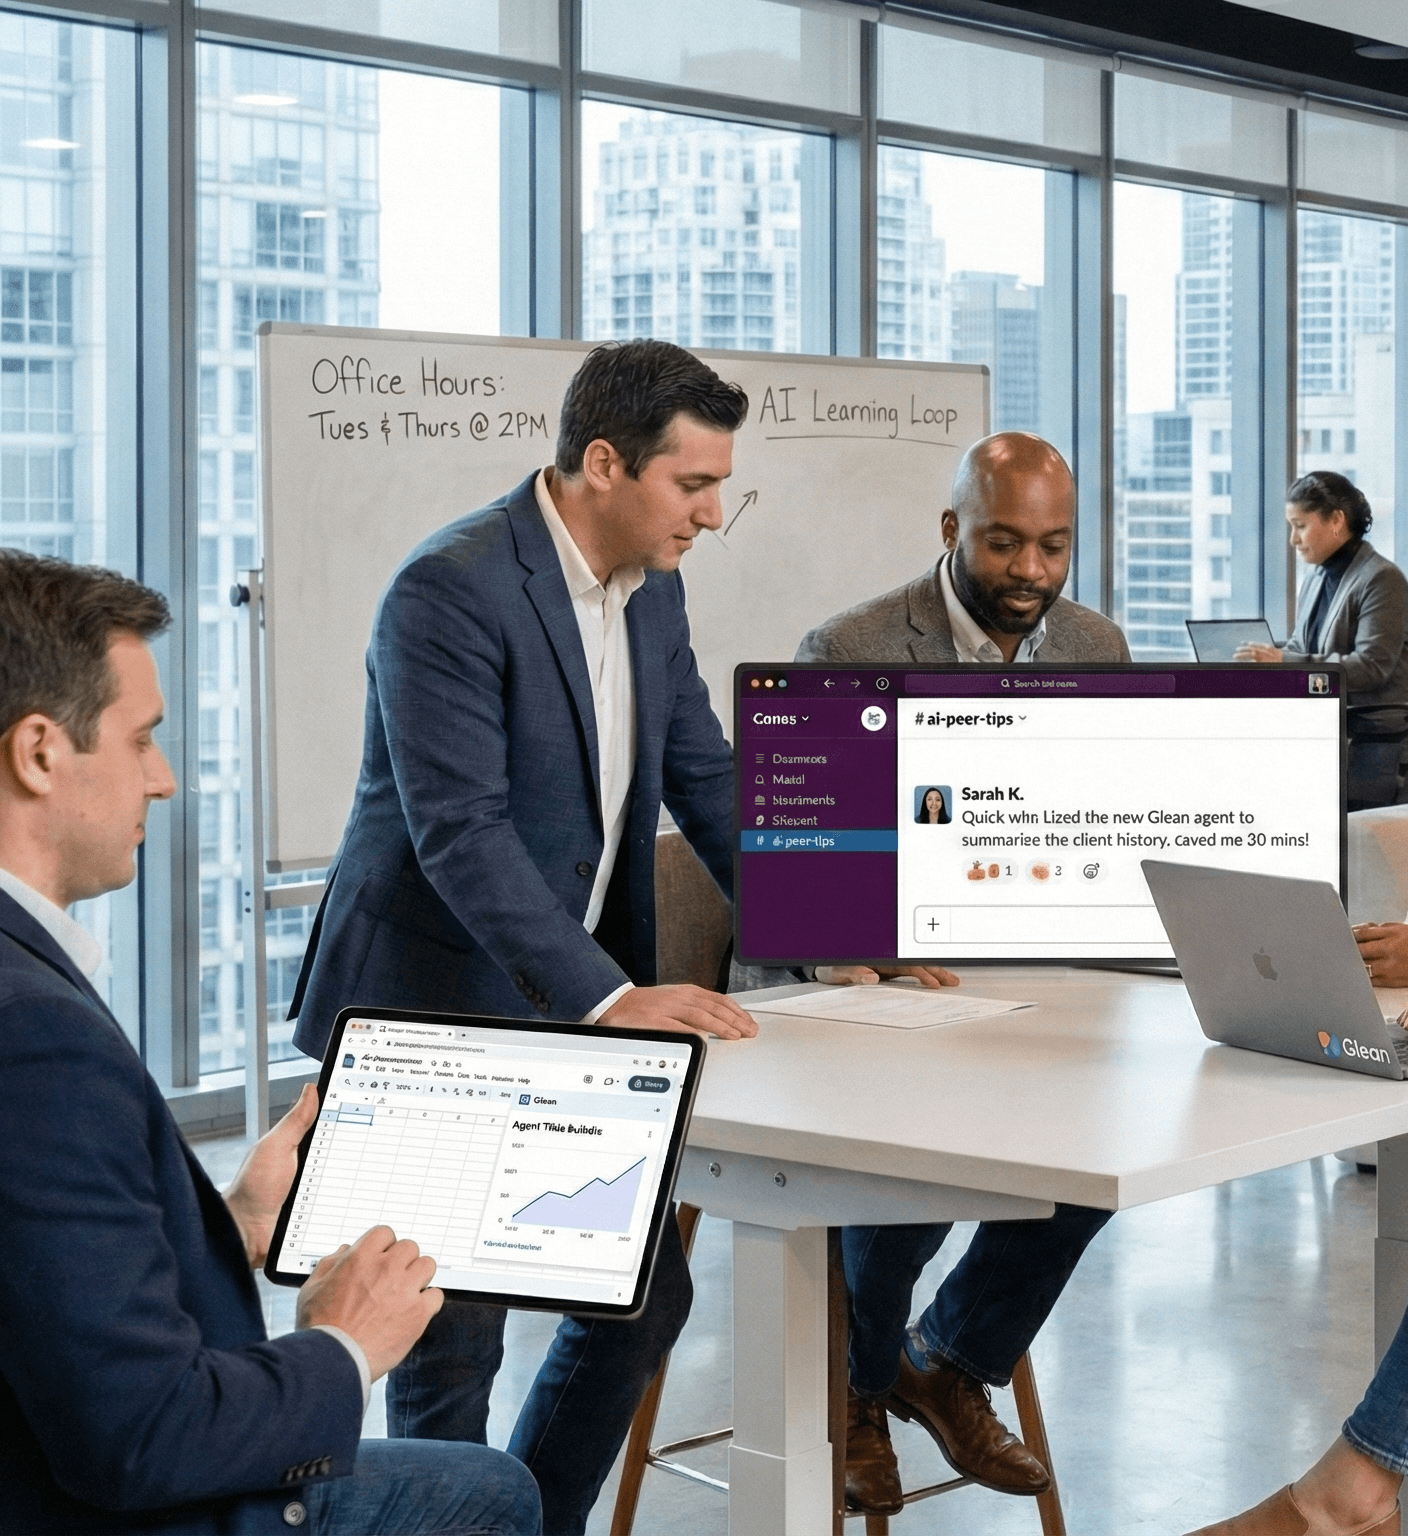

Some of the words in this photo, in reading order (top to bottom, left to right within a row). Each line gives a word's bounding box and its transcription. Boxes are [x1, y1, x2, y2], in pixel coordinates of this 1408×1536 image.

[312, 355, 405, 394] Office
[421, 356, 505, 397] Hours:
[759, 385, 797, 424] AI
[813, 389, 898, 439] Learning
[911, 394, 958, 434] Loop
[308, 410, 369, 440] Tues
[398, 412, 461, 439] Thurs
[469, 412, 489, 441] @
[498, 412, 549, 439] 2PM
[927, 712, 1014, 729] ai-peer-tips
[961, 786, 1004, 801] Sarah
[1008, 786, 1025, 801] K.
[962, 810, 1005, 827] Quick
[1043, 810, 1081, 824] Lized
[1085, 810, 1109, 824] the
[1113, 813, 1144, 824] new
[1147, 810, 1190, 824] Glean
[1194, 811, 1235, 827] agent
[1239, 811, 1255, 824] to
[1045, 833, 1069, 846] the
[1073, 833, 1113, 846] client
[1220, 836, 1243, 846] me
[1247, 833, 1267, 846] 30
[1270, 833, 1309, 846] mins!
[1005, 865, 1012, 876] 1
[1342, 1037, 1391, 1064] Glean
